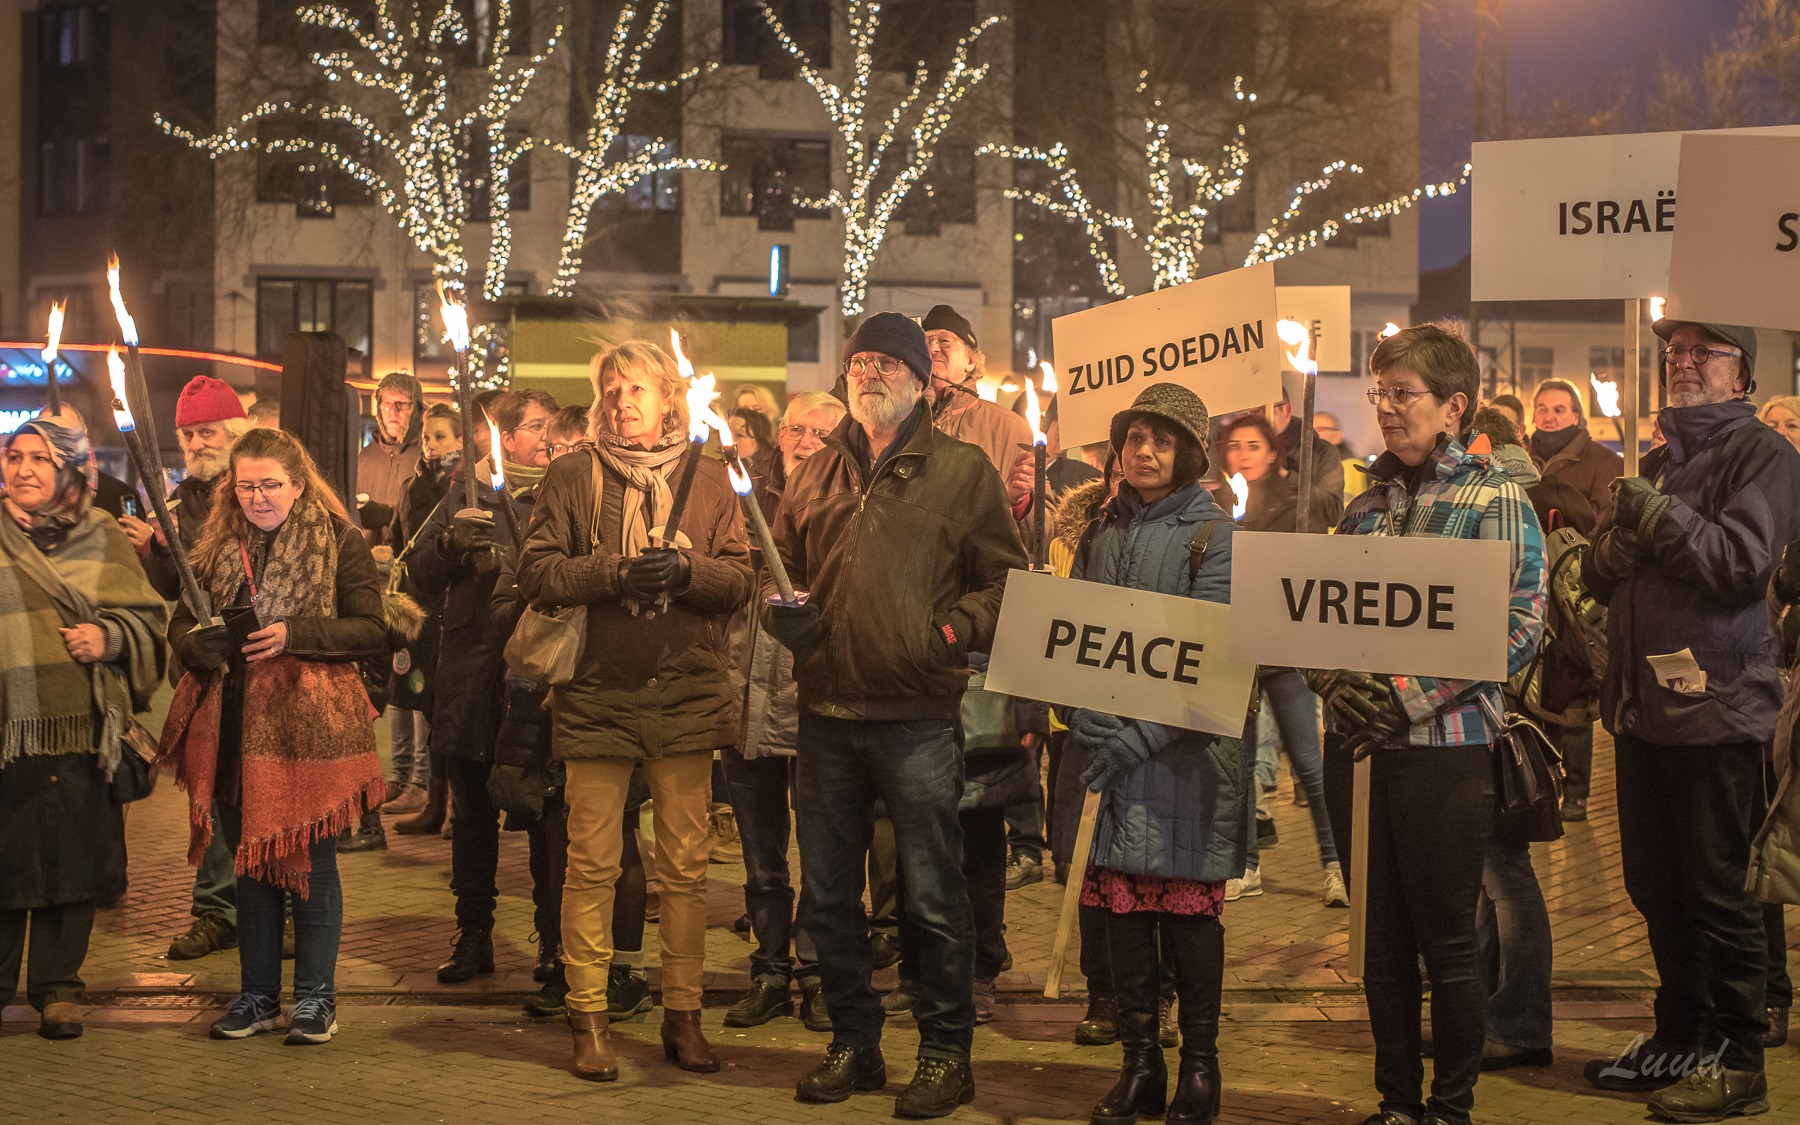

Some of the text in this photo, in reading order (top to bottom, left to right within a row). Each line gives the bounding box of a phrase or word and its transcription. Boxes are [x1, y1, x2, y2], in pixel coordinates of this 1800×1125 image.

[1559, 189, 1677, 236] ISRAË
[1068, 354, 1135, 396] ZUID
[1142, 319, 1265, 377] SOEDAN
[1280, 577, 1456, 631] VREDE
[1044, 618, 1205, 686] PEACE
